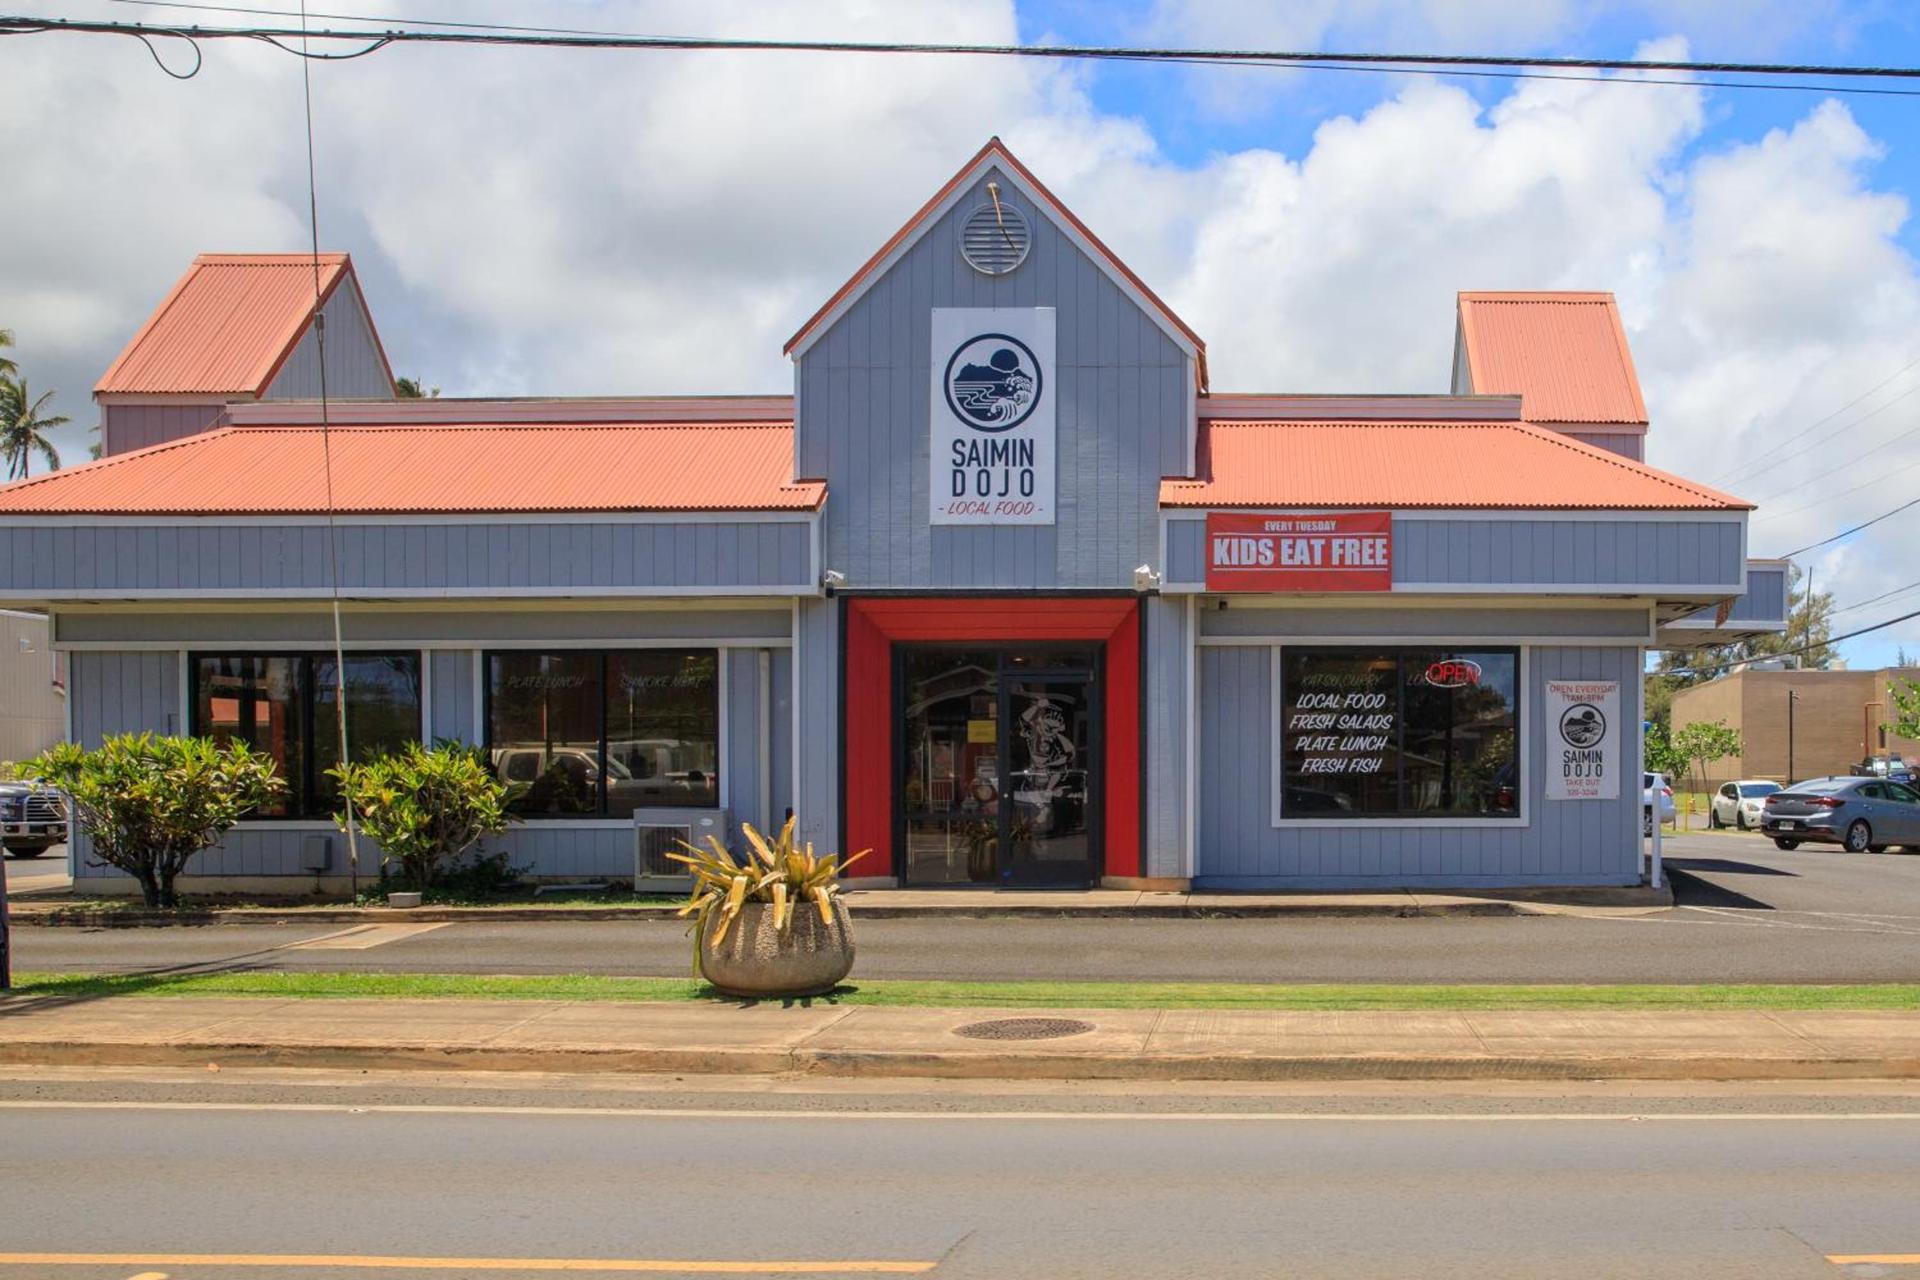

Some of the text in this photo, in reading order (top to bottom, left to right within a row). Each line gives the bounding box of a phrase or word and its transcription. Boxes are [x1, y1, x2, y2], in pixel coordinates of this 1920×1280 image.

[952, 439, 1034, 467] SAIMIN
[952, 469, 1034, 497] DOJO
[948, 501, 1035, 516] LOCAL FOOD
[1265, 521, 1336, 531] EVERY TUESDAY
[1213, 538, 1388, 565] KIDS EAT FREE
[1429, 663, 1479, 686] OPEN
[1550, 684, 1616, 694] OPEN EVERYDAY
[1296, 693, 1386, 708] LOCAL FOOD
[1289, 714, 1393, 729] FRESH SALADS
[1295, 736, 1388, 751] PLATE LUNCH
[1563, 750, 1602, 763] SAIMIN
[1301, 758, 1383, 773] FRESH FISH
[1563, 764, 1602, 777] DOJO
